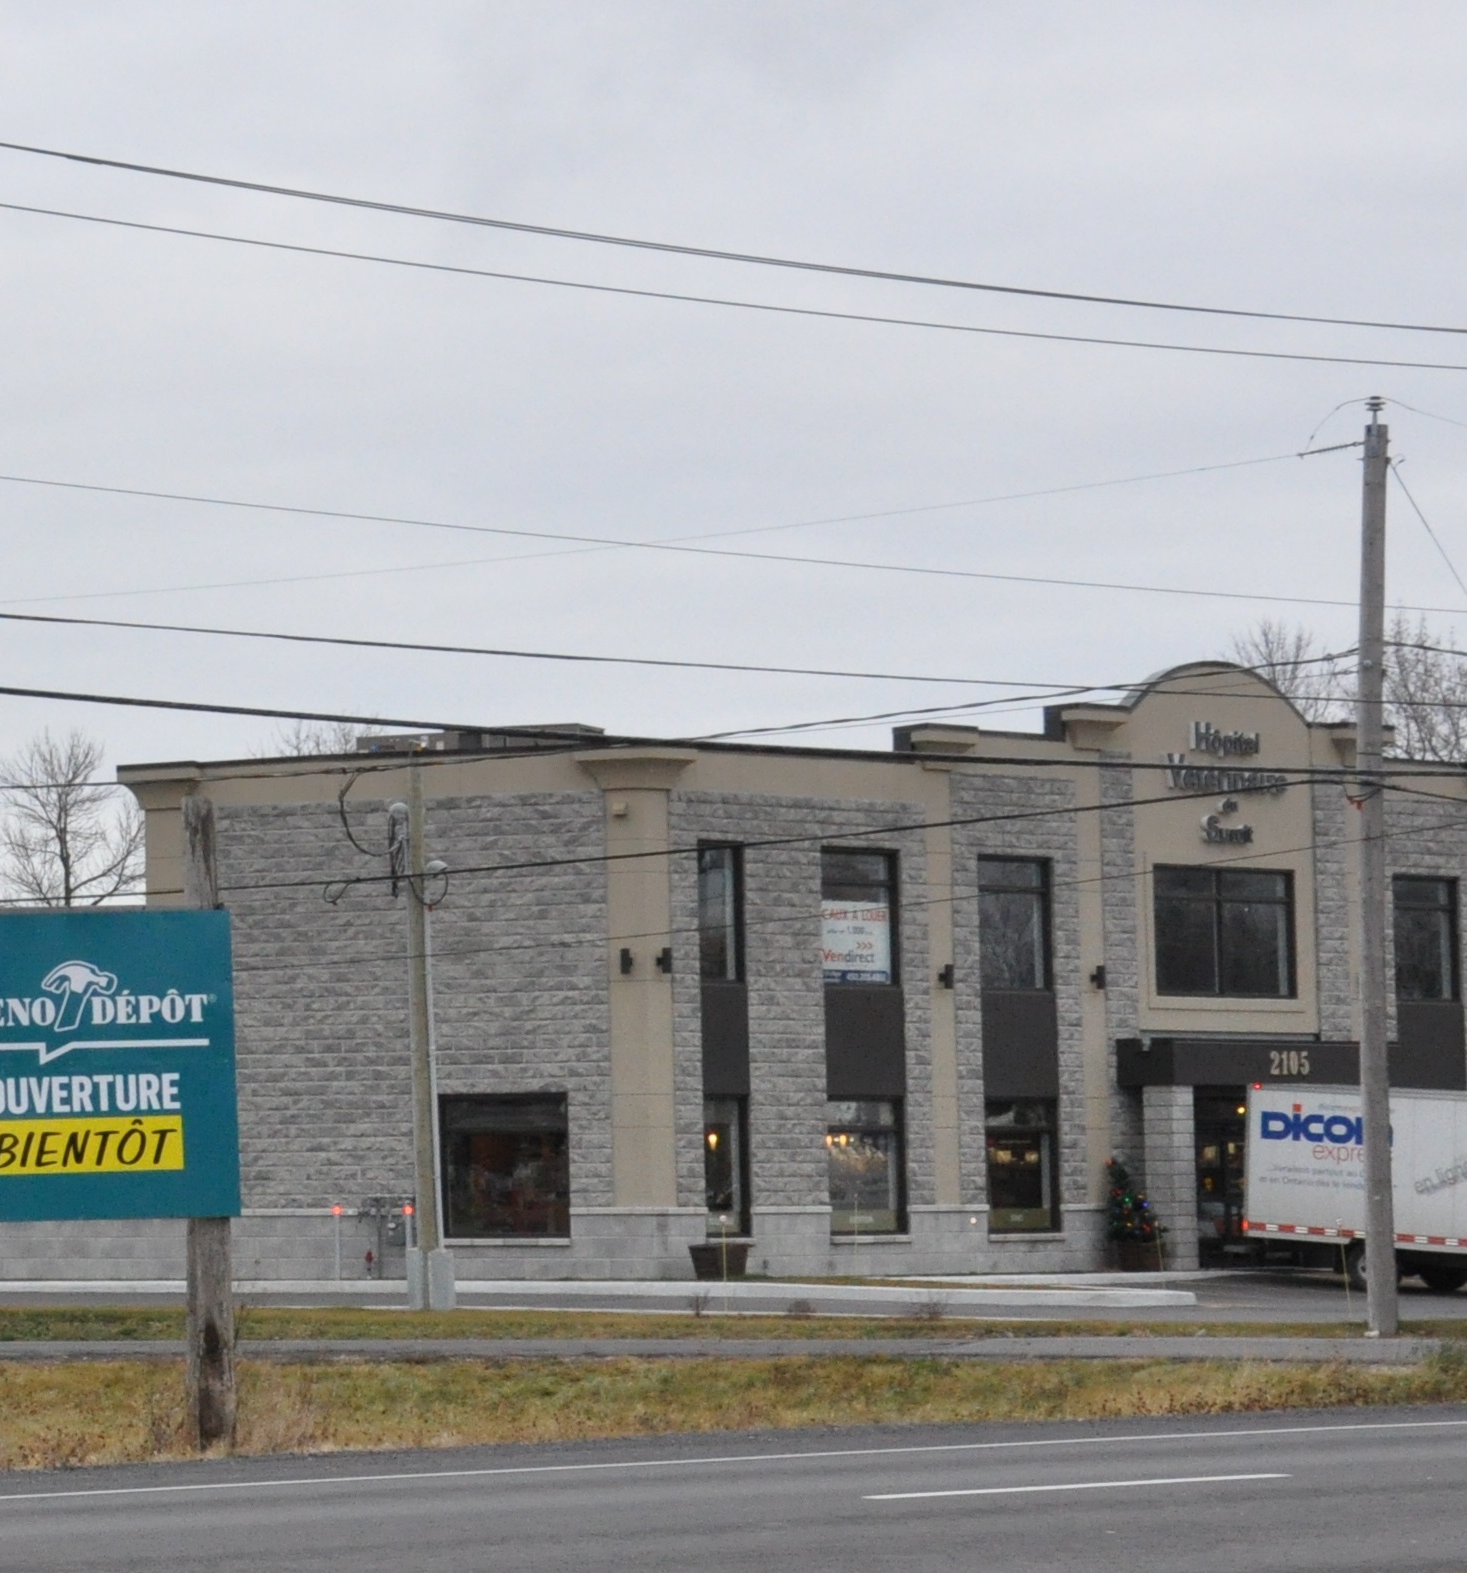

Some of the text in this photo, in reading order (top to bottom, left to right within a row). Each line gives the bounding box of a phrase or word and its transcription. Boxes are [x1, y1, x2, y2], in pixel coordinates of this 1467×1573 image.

[1190, 720, 1260, 757] Hôpital
[822, 948, 875, 963] Vendirect
[91, 988, 209, 1025] DÉPÔT
[1269, 1050, 1311, 1076] 2105
[1312, 1145, 1365, 1165] expre
